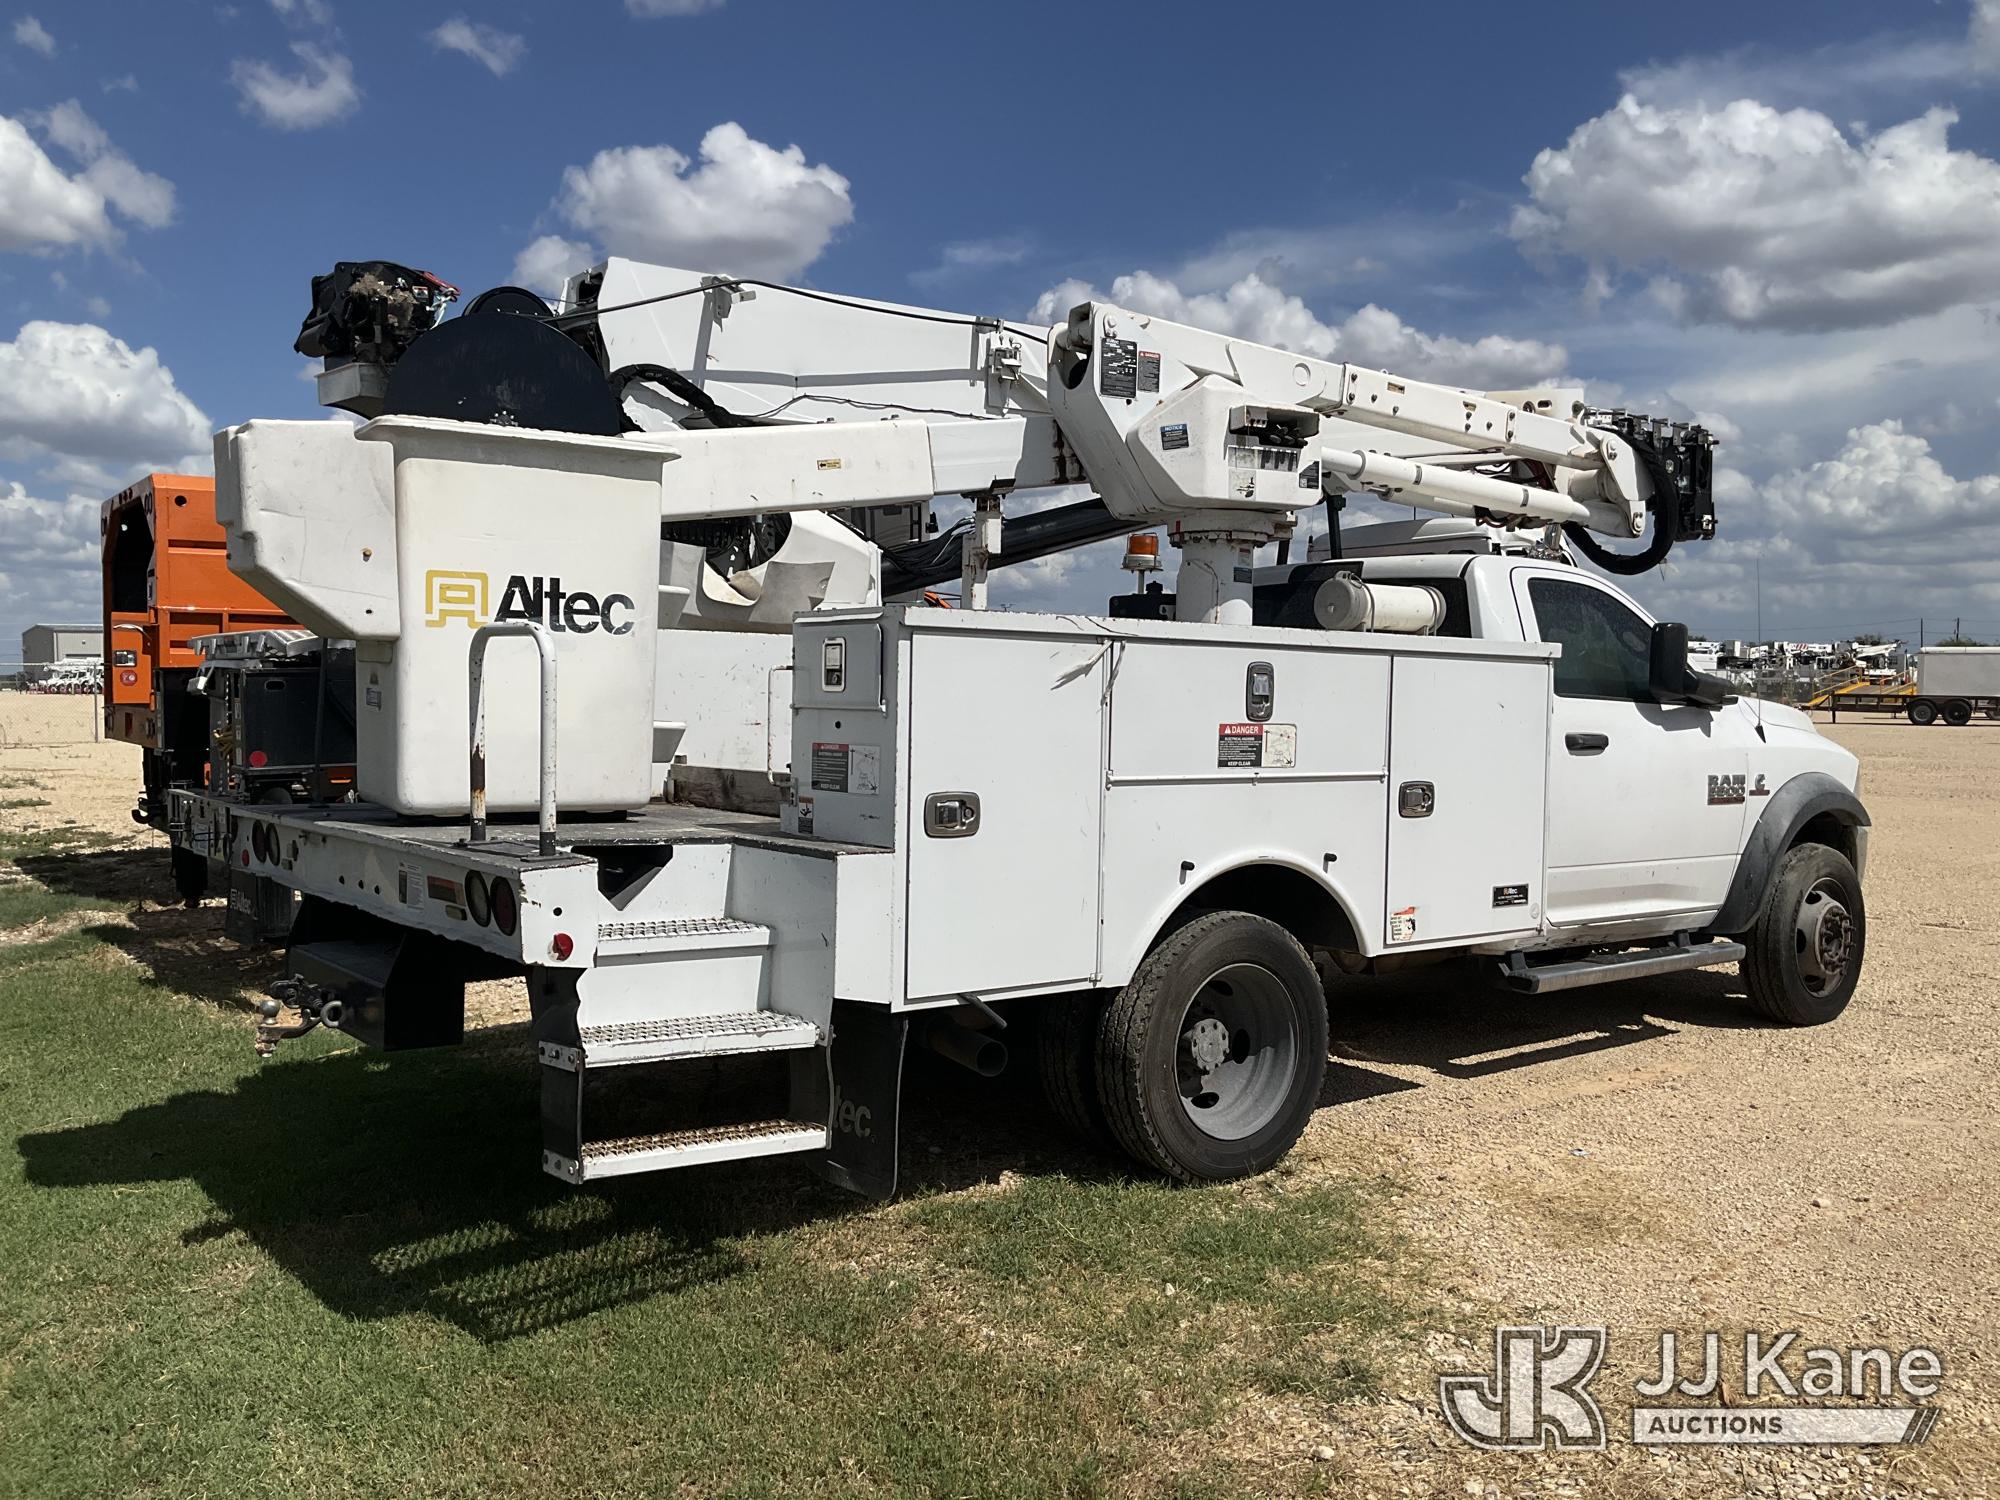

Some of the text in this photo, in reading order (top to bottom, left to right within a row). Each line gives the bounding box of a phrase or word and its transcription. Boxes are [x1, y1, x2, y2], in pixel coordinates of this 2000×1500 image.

[494, 575, 635, 635] Altec
[1232, 726, 1259, 734] DANGER
[1708, 775, 1746, 787] RAM
